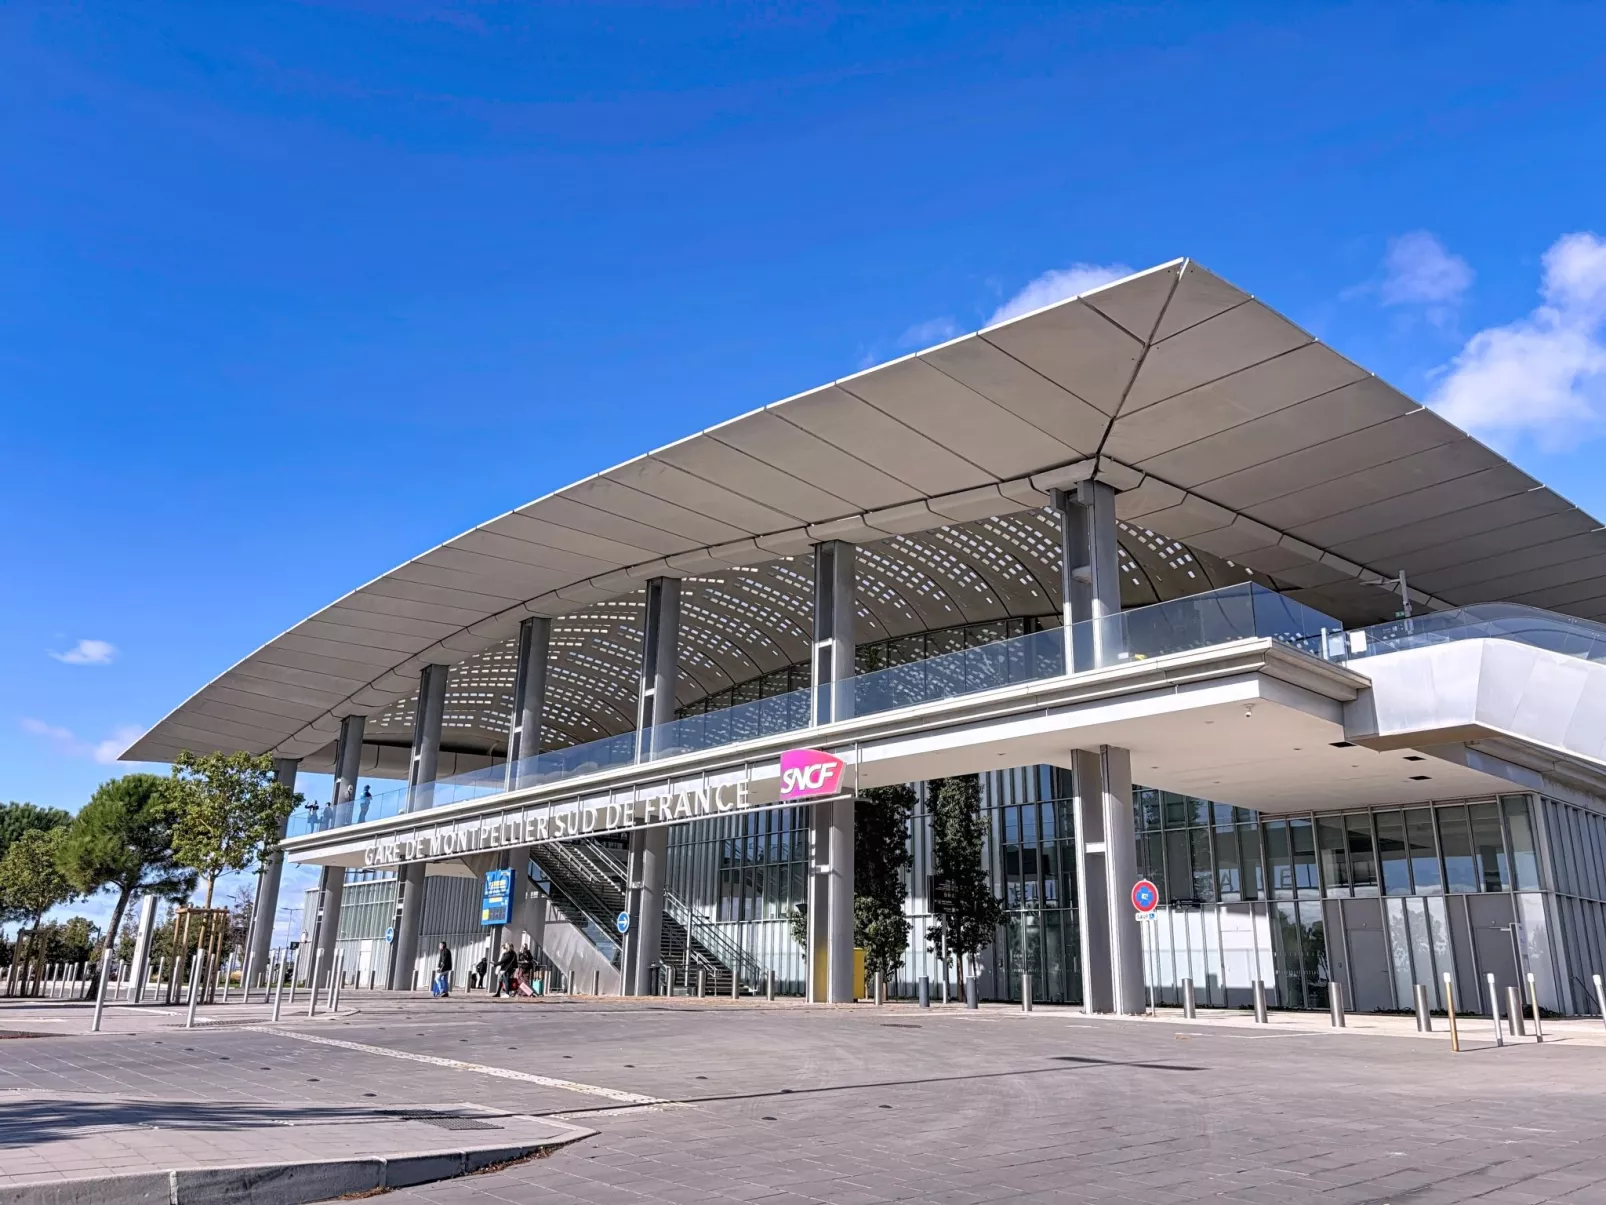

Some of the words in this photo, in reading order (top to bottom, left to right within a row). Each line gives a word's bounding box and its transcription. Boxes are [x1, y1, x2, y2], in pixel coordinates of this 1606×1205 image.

[781, 763, 836, 794] SNCF
[365, 842, 400, 865] GARE
[405, 837, 425, 860] DE
[430, 818, 548, 853] MONTPELLIER
[554, 808, 598, 836] SUD
[605, 803, 635, 829] DE
[646, 781, 749, 822] FRANCE
